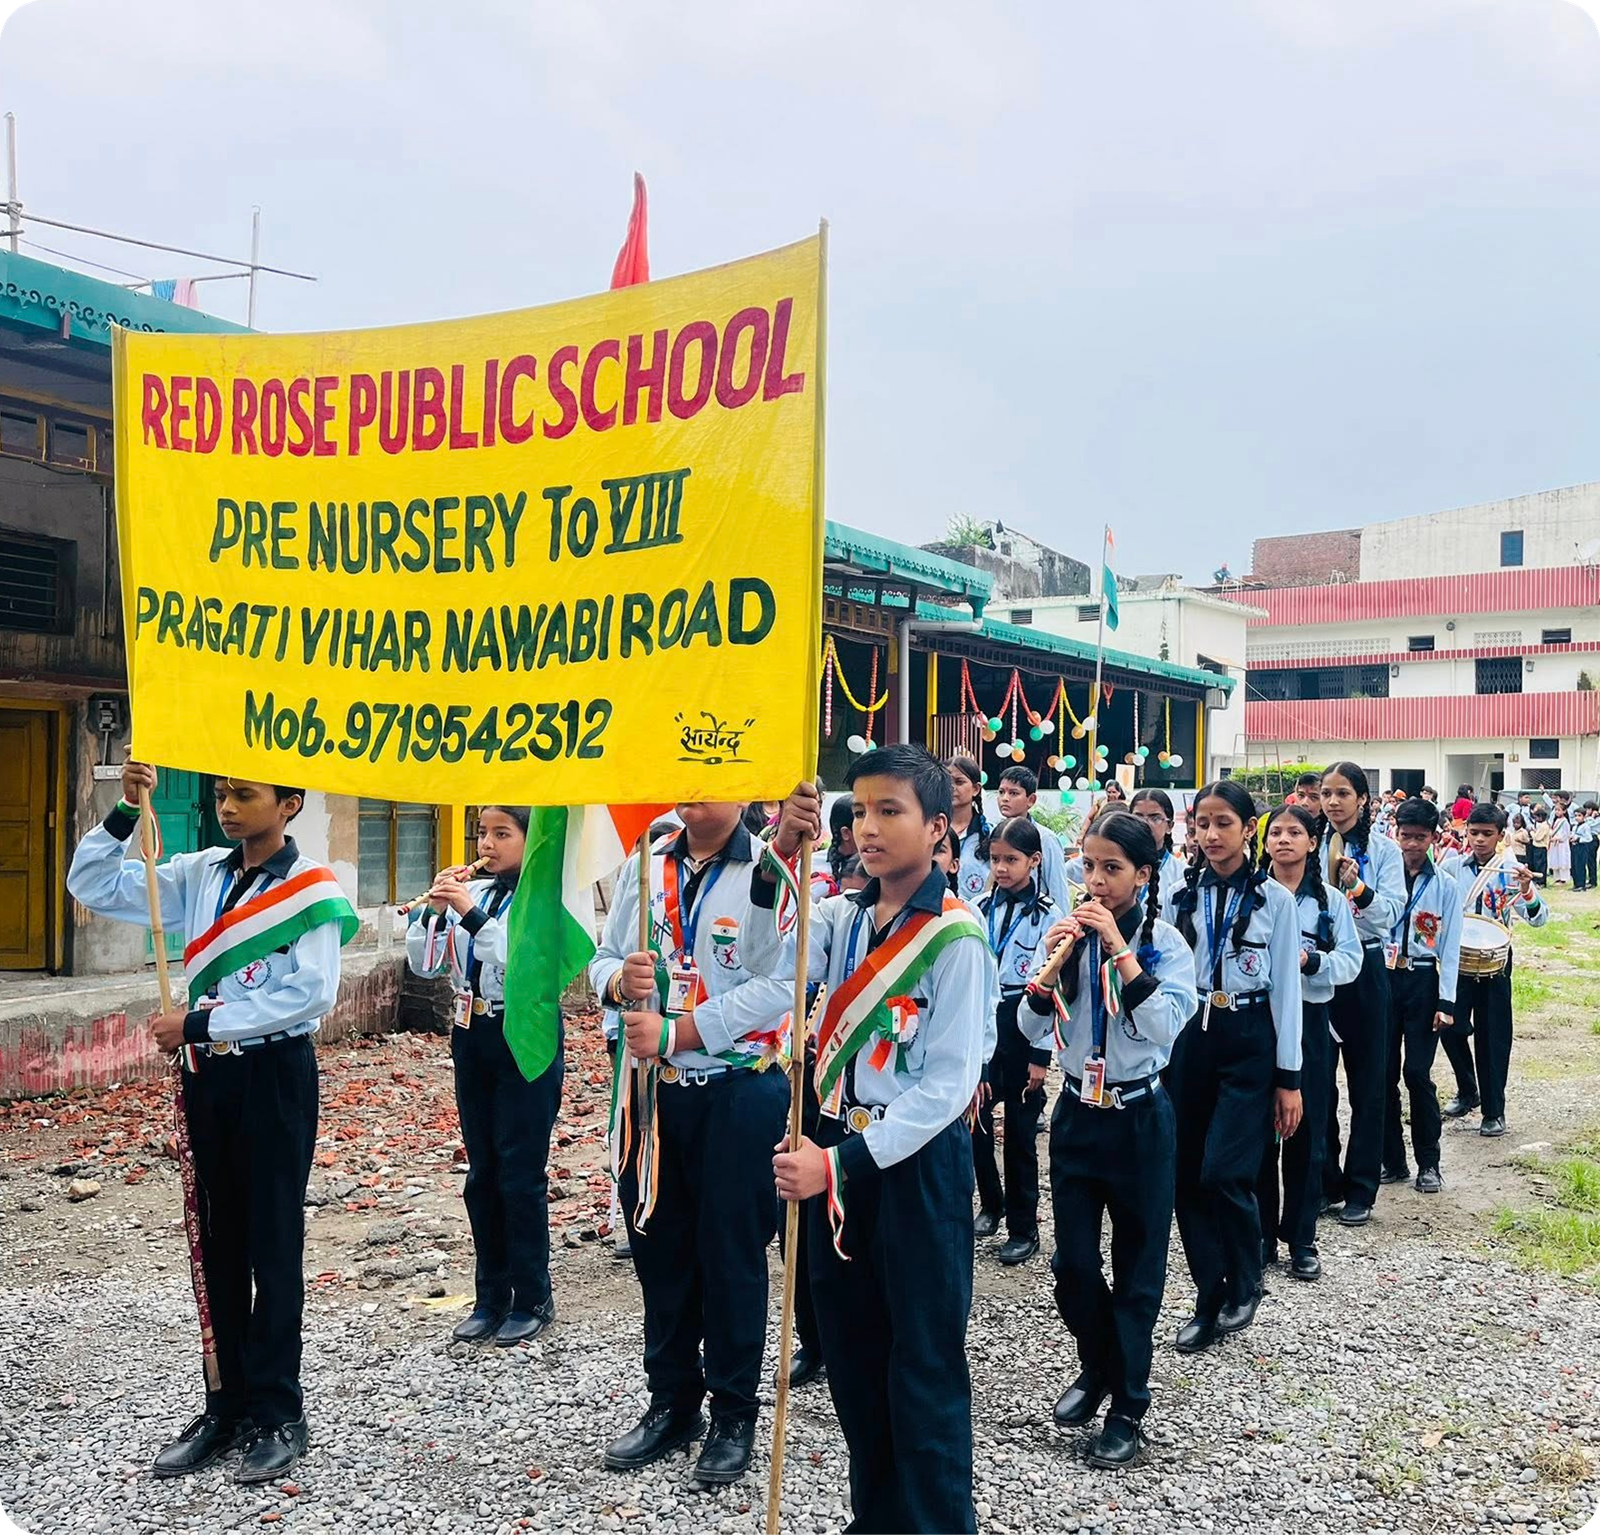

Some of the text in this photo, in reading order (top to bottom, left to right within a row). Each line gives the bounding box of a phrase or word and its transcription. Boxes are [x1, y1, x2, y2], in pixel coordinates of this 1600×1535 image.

[141, 297, 805, 458] RED ROSE PUBLIC SCHOOL
[209, 498, 300, 570] PRE
[307, 491, 528, 575] NURSERY
[600, 467, 692, 555] VIII
[135, 576, 777, 674] PRAGATI VIHAR NAWABI ROAD
